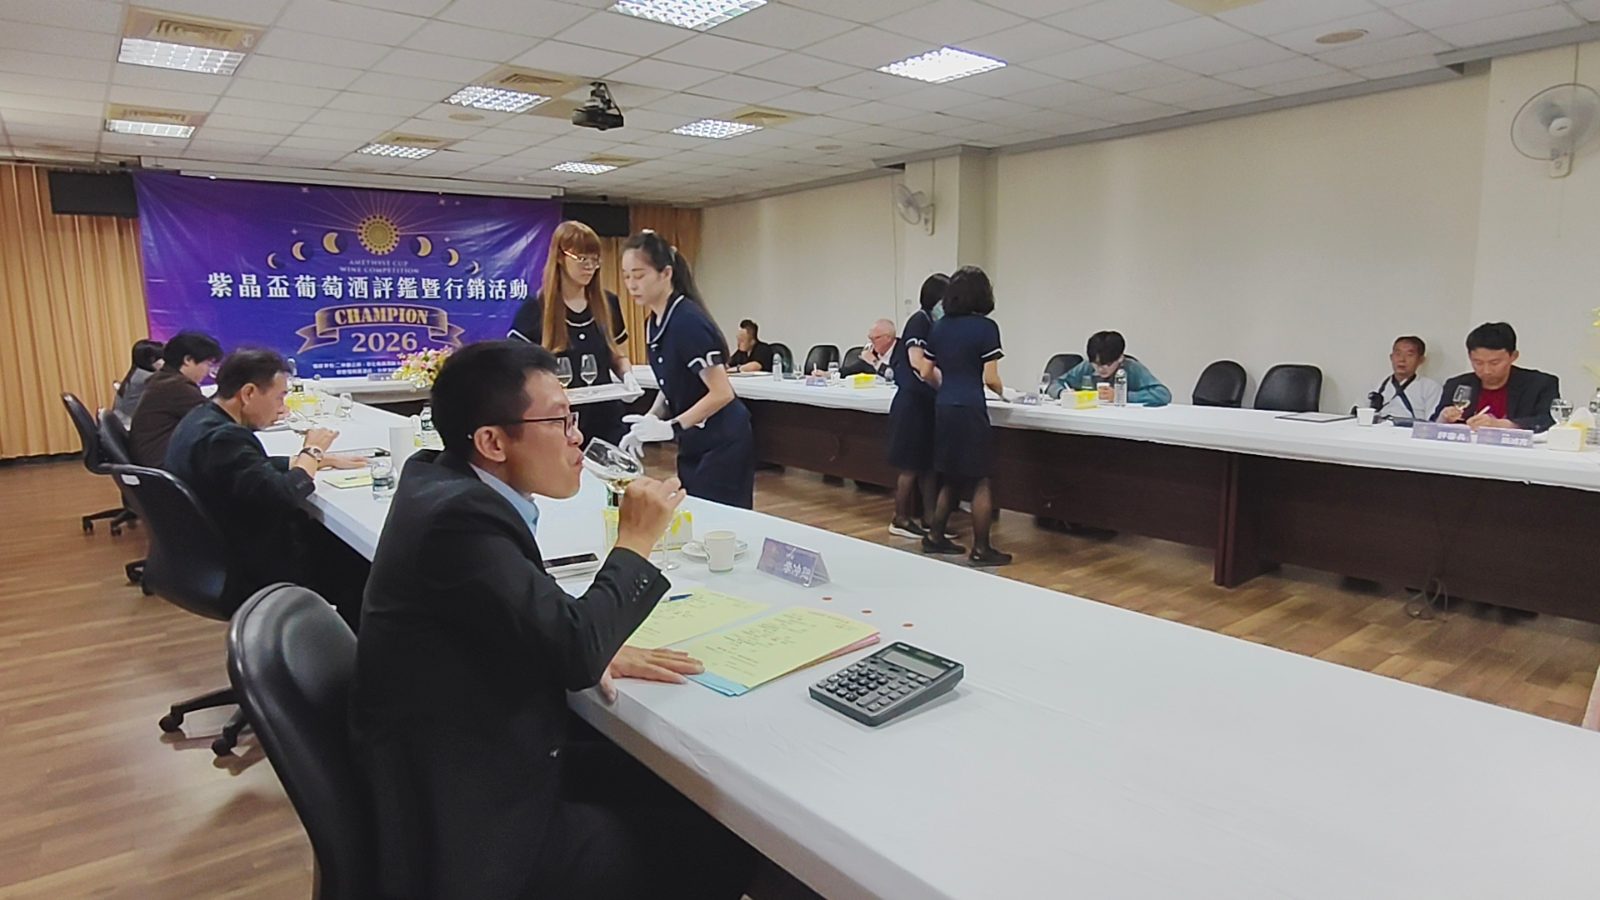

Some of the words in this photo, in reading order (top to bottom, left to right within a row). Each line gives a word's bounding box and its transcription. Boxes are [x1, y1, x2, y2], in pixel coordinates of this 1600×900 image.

[363, 266, 420, 274] COMPETITION
[207, 272, 528, 300] 紫晶盃葡萄酒評鑑暨行銷活動
[334, 307, 429, 325] CHAMPION
[351, 331, 418, 352] 2026
